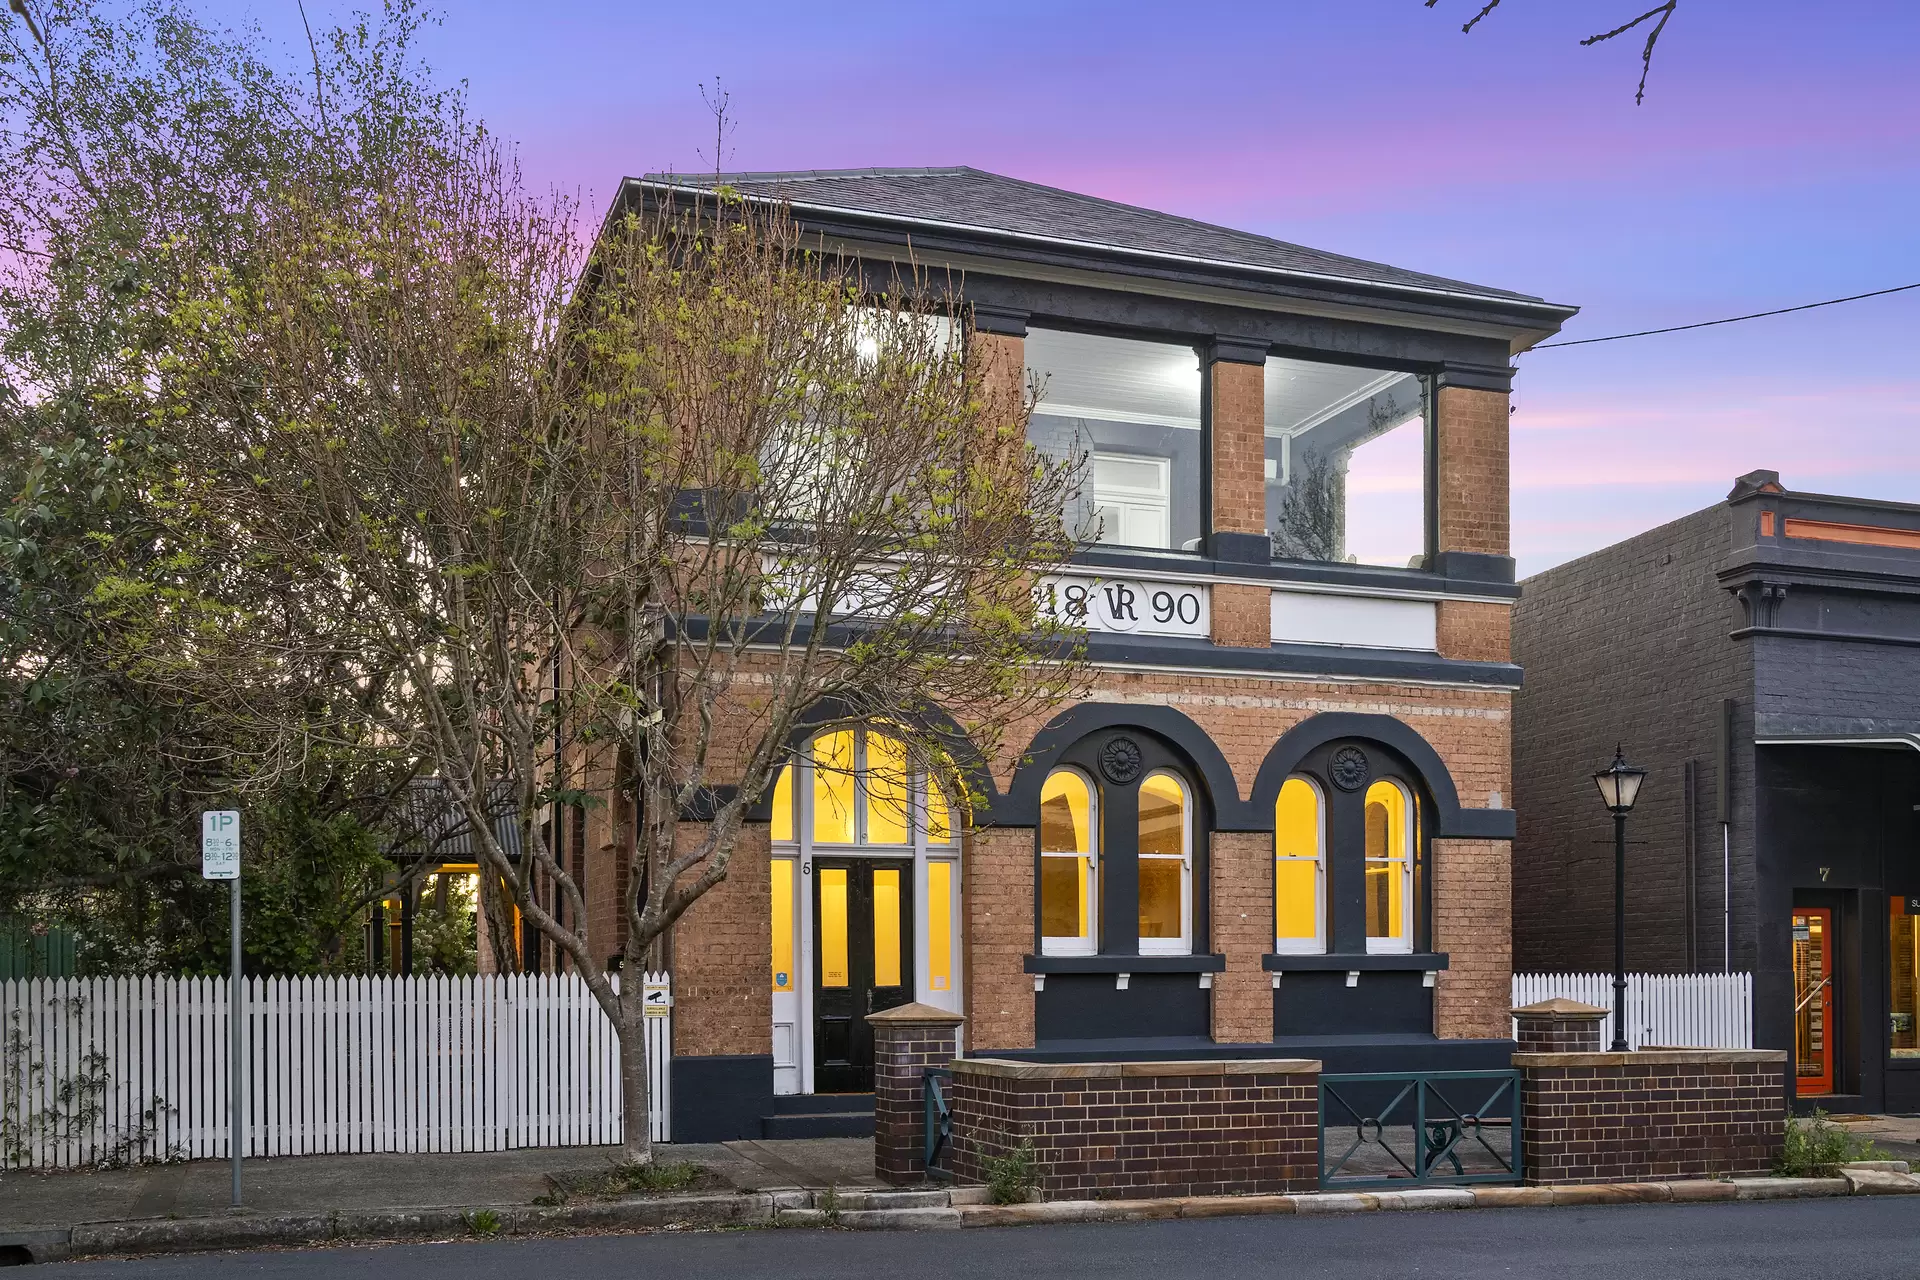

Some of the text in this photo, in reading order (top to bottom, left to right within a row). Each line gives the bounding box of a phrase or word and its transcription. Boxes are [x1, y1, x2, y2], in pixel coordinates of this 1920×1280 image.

[1152, 591, 1200, 625] 90
[210, 815, 233, 831] 1P
[802, 861, 811, 875] 5
[1819, 867, 1831, 882] 7
